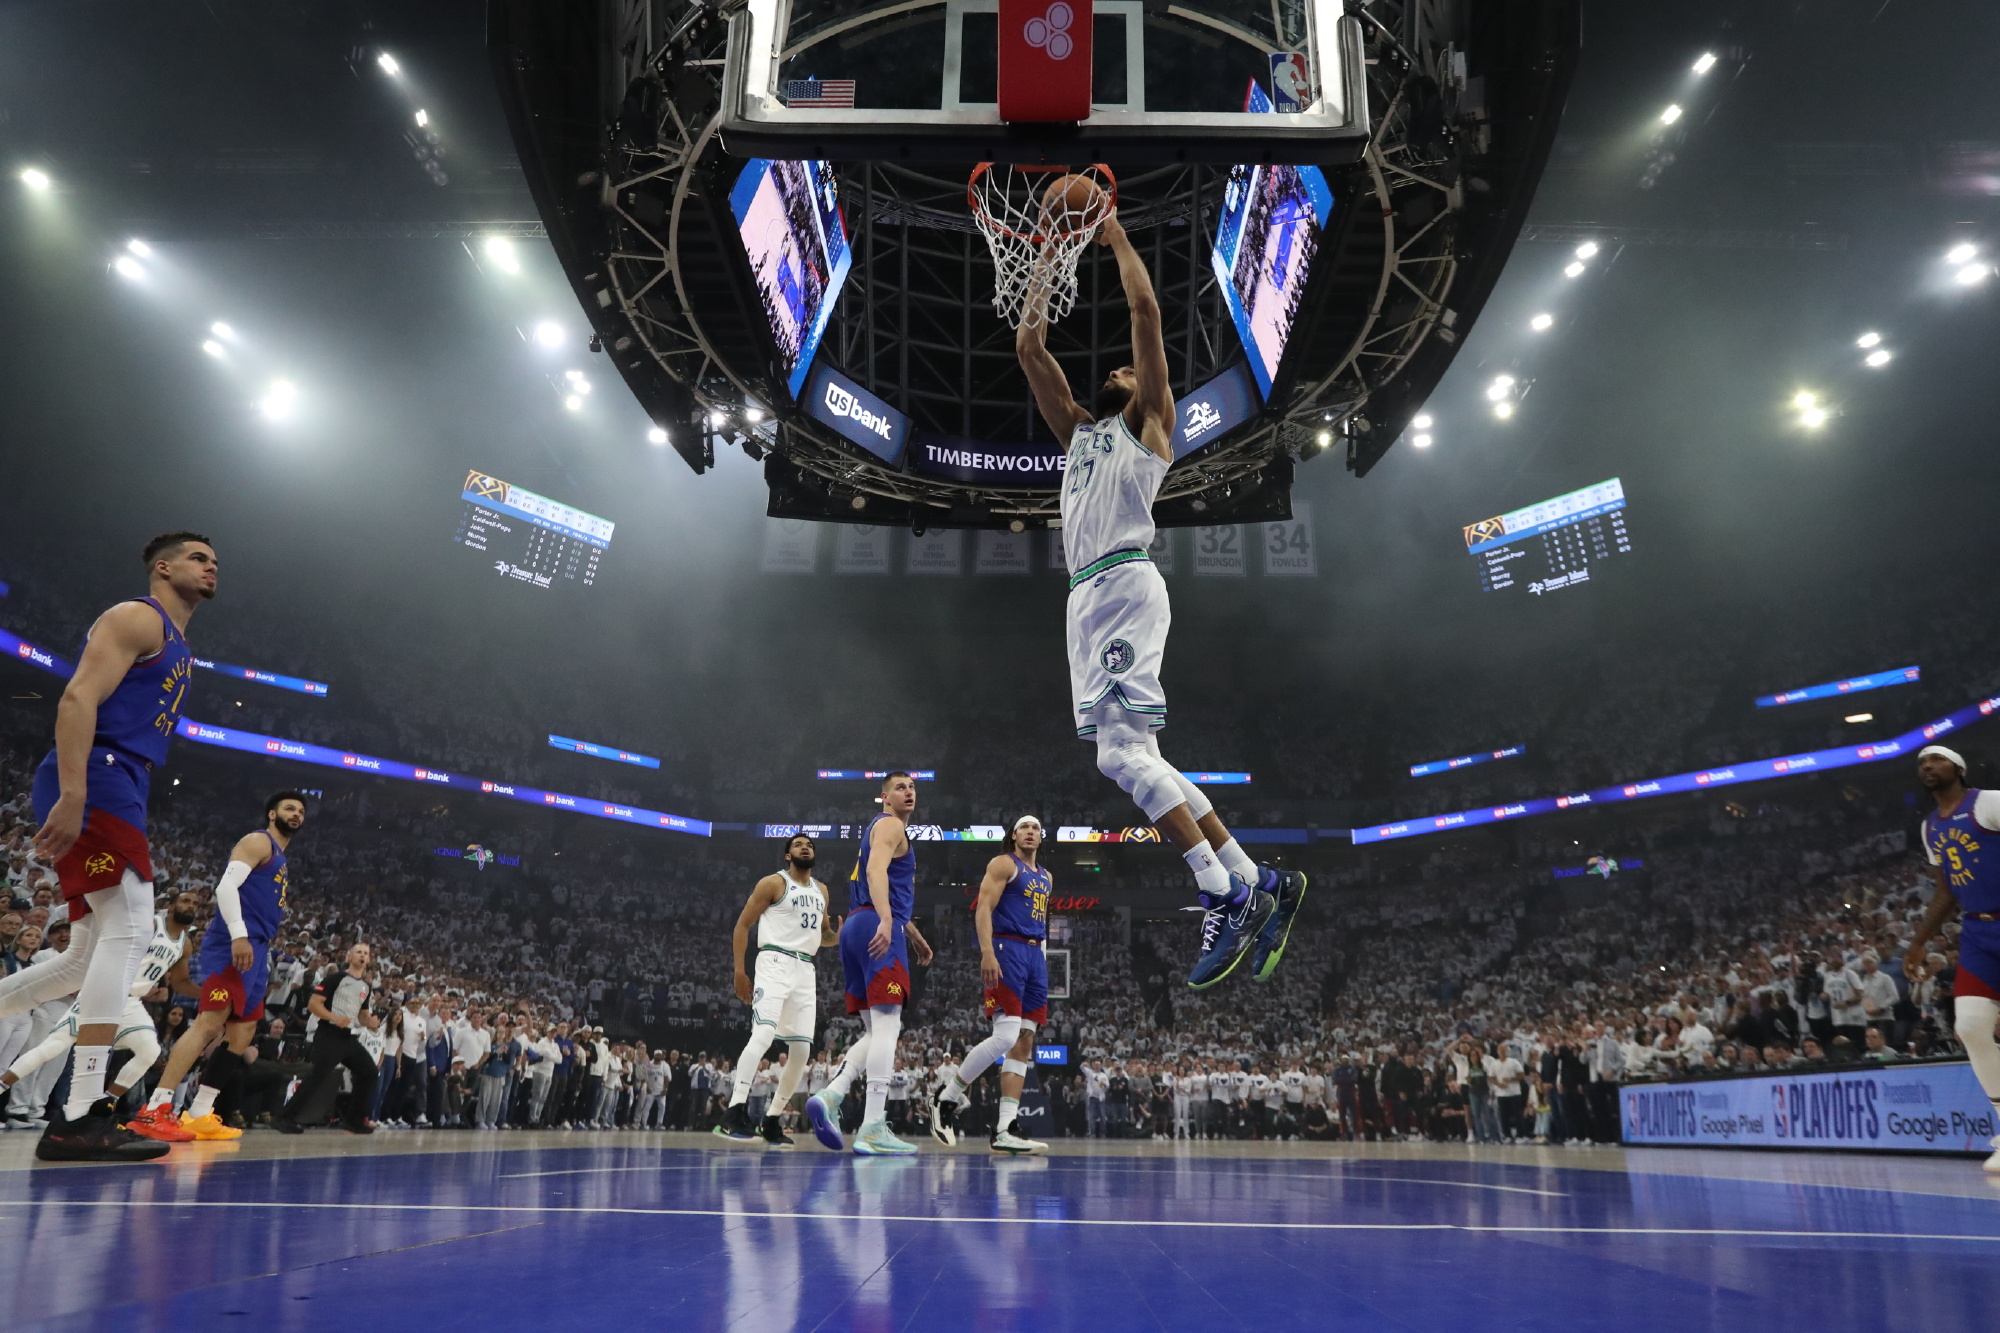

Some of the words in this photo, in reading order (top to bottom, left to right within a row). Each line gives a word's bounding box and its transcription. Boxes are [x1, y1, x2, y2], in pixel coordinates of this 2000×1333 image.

[1279, 102, 1296, 112] NBA
[828, 390, 847, 411] us
[850, 389, 891, 440] bank
[926, 444, 1066, 472] TIMBERWOLVE
[1070, 457, 1096, 496] 27
[1201, 524, 1238, 554] 32
[1269, 524, 1310, 554] 34
[1198, 557, 1242, 567] BRUNSON
[1272, 557, 1308, 568] FOWLES
[31, 647, 53, 667] bank
[256, 671, 276, 682] bank
[171, 684, 185, 713] 1
[155, 713, 174, 736] CIT
[199, 727, 226, 741] bank
[280, 743, 306, 756] bank
[1873, 742, 1900, 755] bank
[356, 757, 380, 770] bank
[1788, 757, 1816, 769] bank
[427, 770, 449, 783] bank
[1710, 770, 1735, 782] bank
[494, 783, 514, 796] bank
[1636, 782, 1660, 794] bank
[556, 796, 575, 807] bank
[1568, 793, 1591, 805] bank
[614, 806, 633, 818] bank
[1505, 804, 1526, 816] bank
[669, 817, 687, 828] bank
[1446, 815, 1465, 826] bank
[765, 825, 800, 837] KFAN
[987, 830, 993, 839] 0
[1070, 831, 1075, 840] 0
[1390, 824, 1408, 835] bank
[1949, 828, 1980, 852] HIGH
[434, 847, 462, 858] reasure
[1946, 847, 1962, 870] 5
[1950, 869, 1975, 886] CITY
[792, 894, 824, 914] WOLVES
[1033, 892, 1046, 912] 50
[801, 913, 817, 929] 32
[146, 945, 176, 966] WOLVE
[143, 963, 161, 981] 10
[1038, 1051, 1061, 1059] TAIR
[1638, 1090, 1696, 1137] PLAYOFFS
[1789, 1079, 1878, 1139] PLAYOFFS
[1701, 1114, 1738, 1138] Google
[1739, 1113, 1764, 1133] Pixel
[1888, 1111, 1948, 1143] Google
[1952, 1111, 1994, 1136] Pixel
